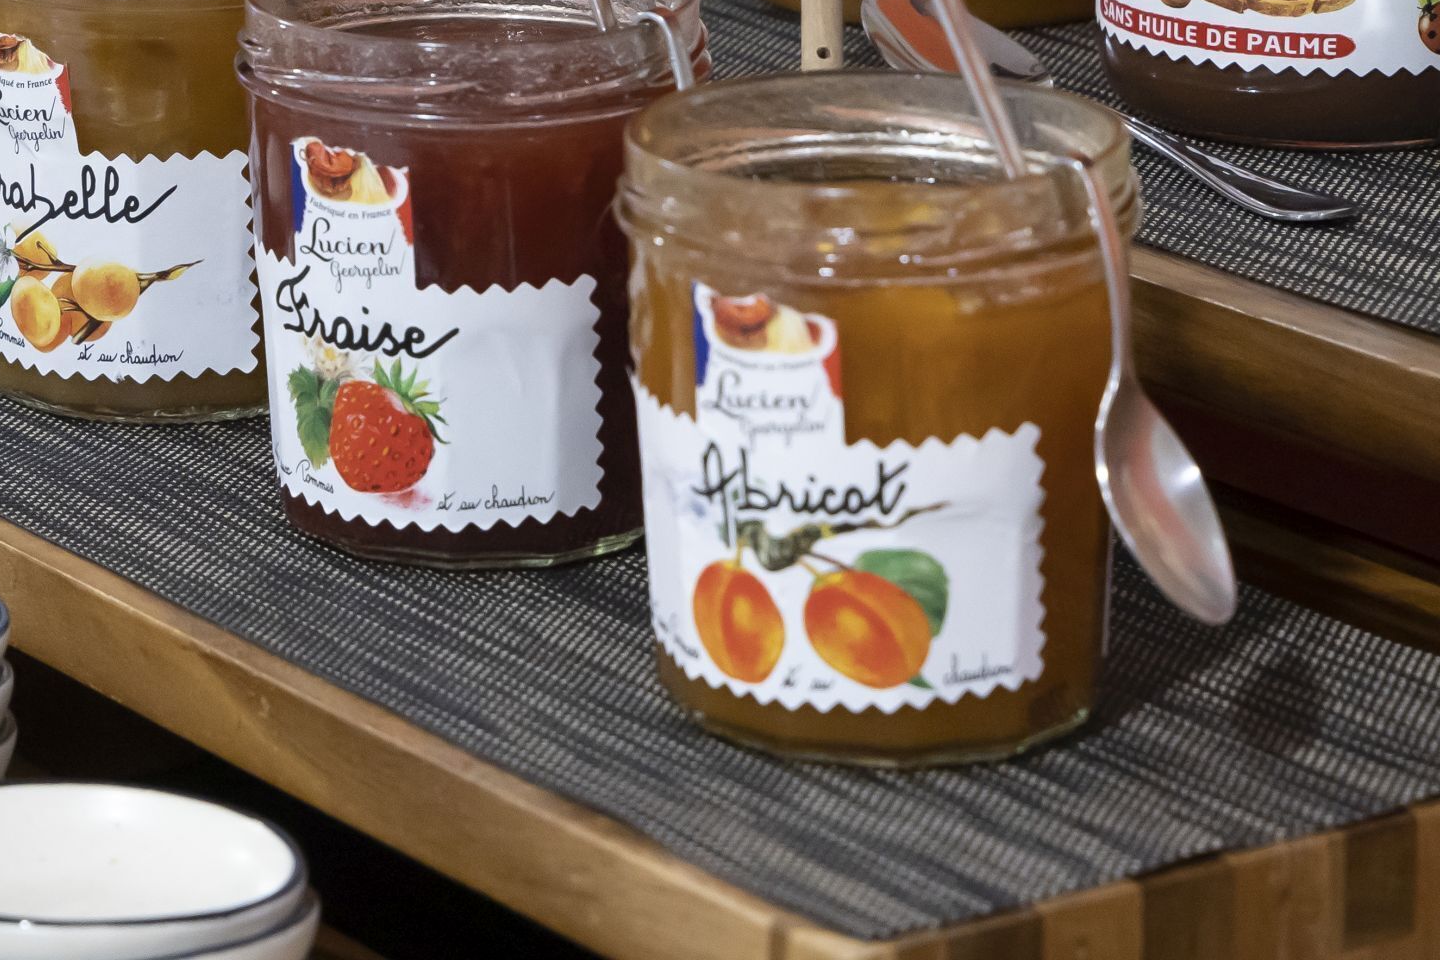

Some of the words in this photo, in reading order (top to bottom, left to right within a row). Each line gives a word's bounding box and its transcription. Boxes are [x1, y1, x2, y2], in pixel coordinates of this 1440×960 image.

[1103, 0, 1134, 29] SANS
[1138, 16, 1198, 45] HUILE
[1206, 27, 1237, 50] DE
[1246, 33, 1338, 56] PALME
[16, 81, 25, 89] en
[27, 78, 53, 89] France
[361, 209, 391, 220] France
[300, 217, 396, 262] Lucien
[275, 264, 460, 360] Fraise
[120, 340, 185, 365] chaudron
[484, 484, 555, 514] chaudron
[692, 440, 910, 550] Abricot
